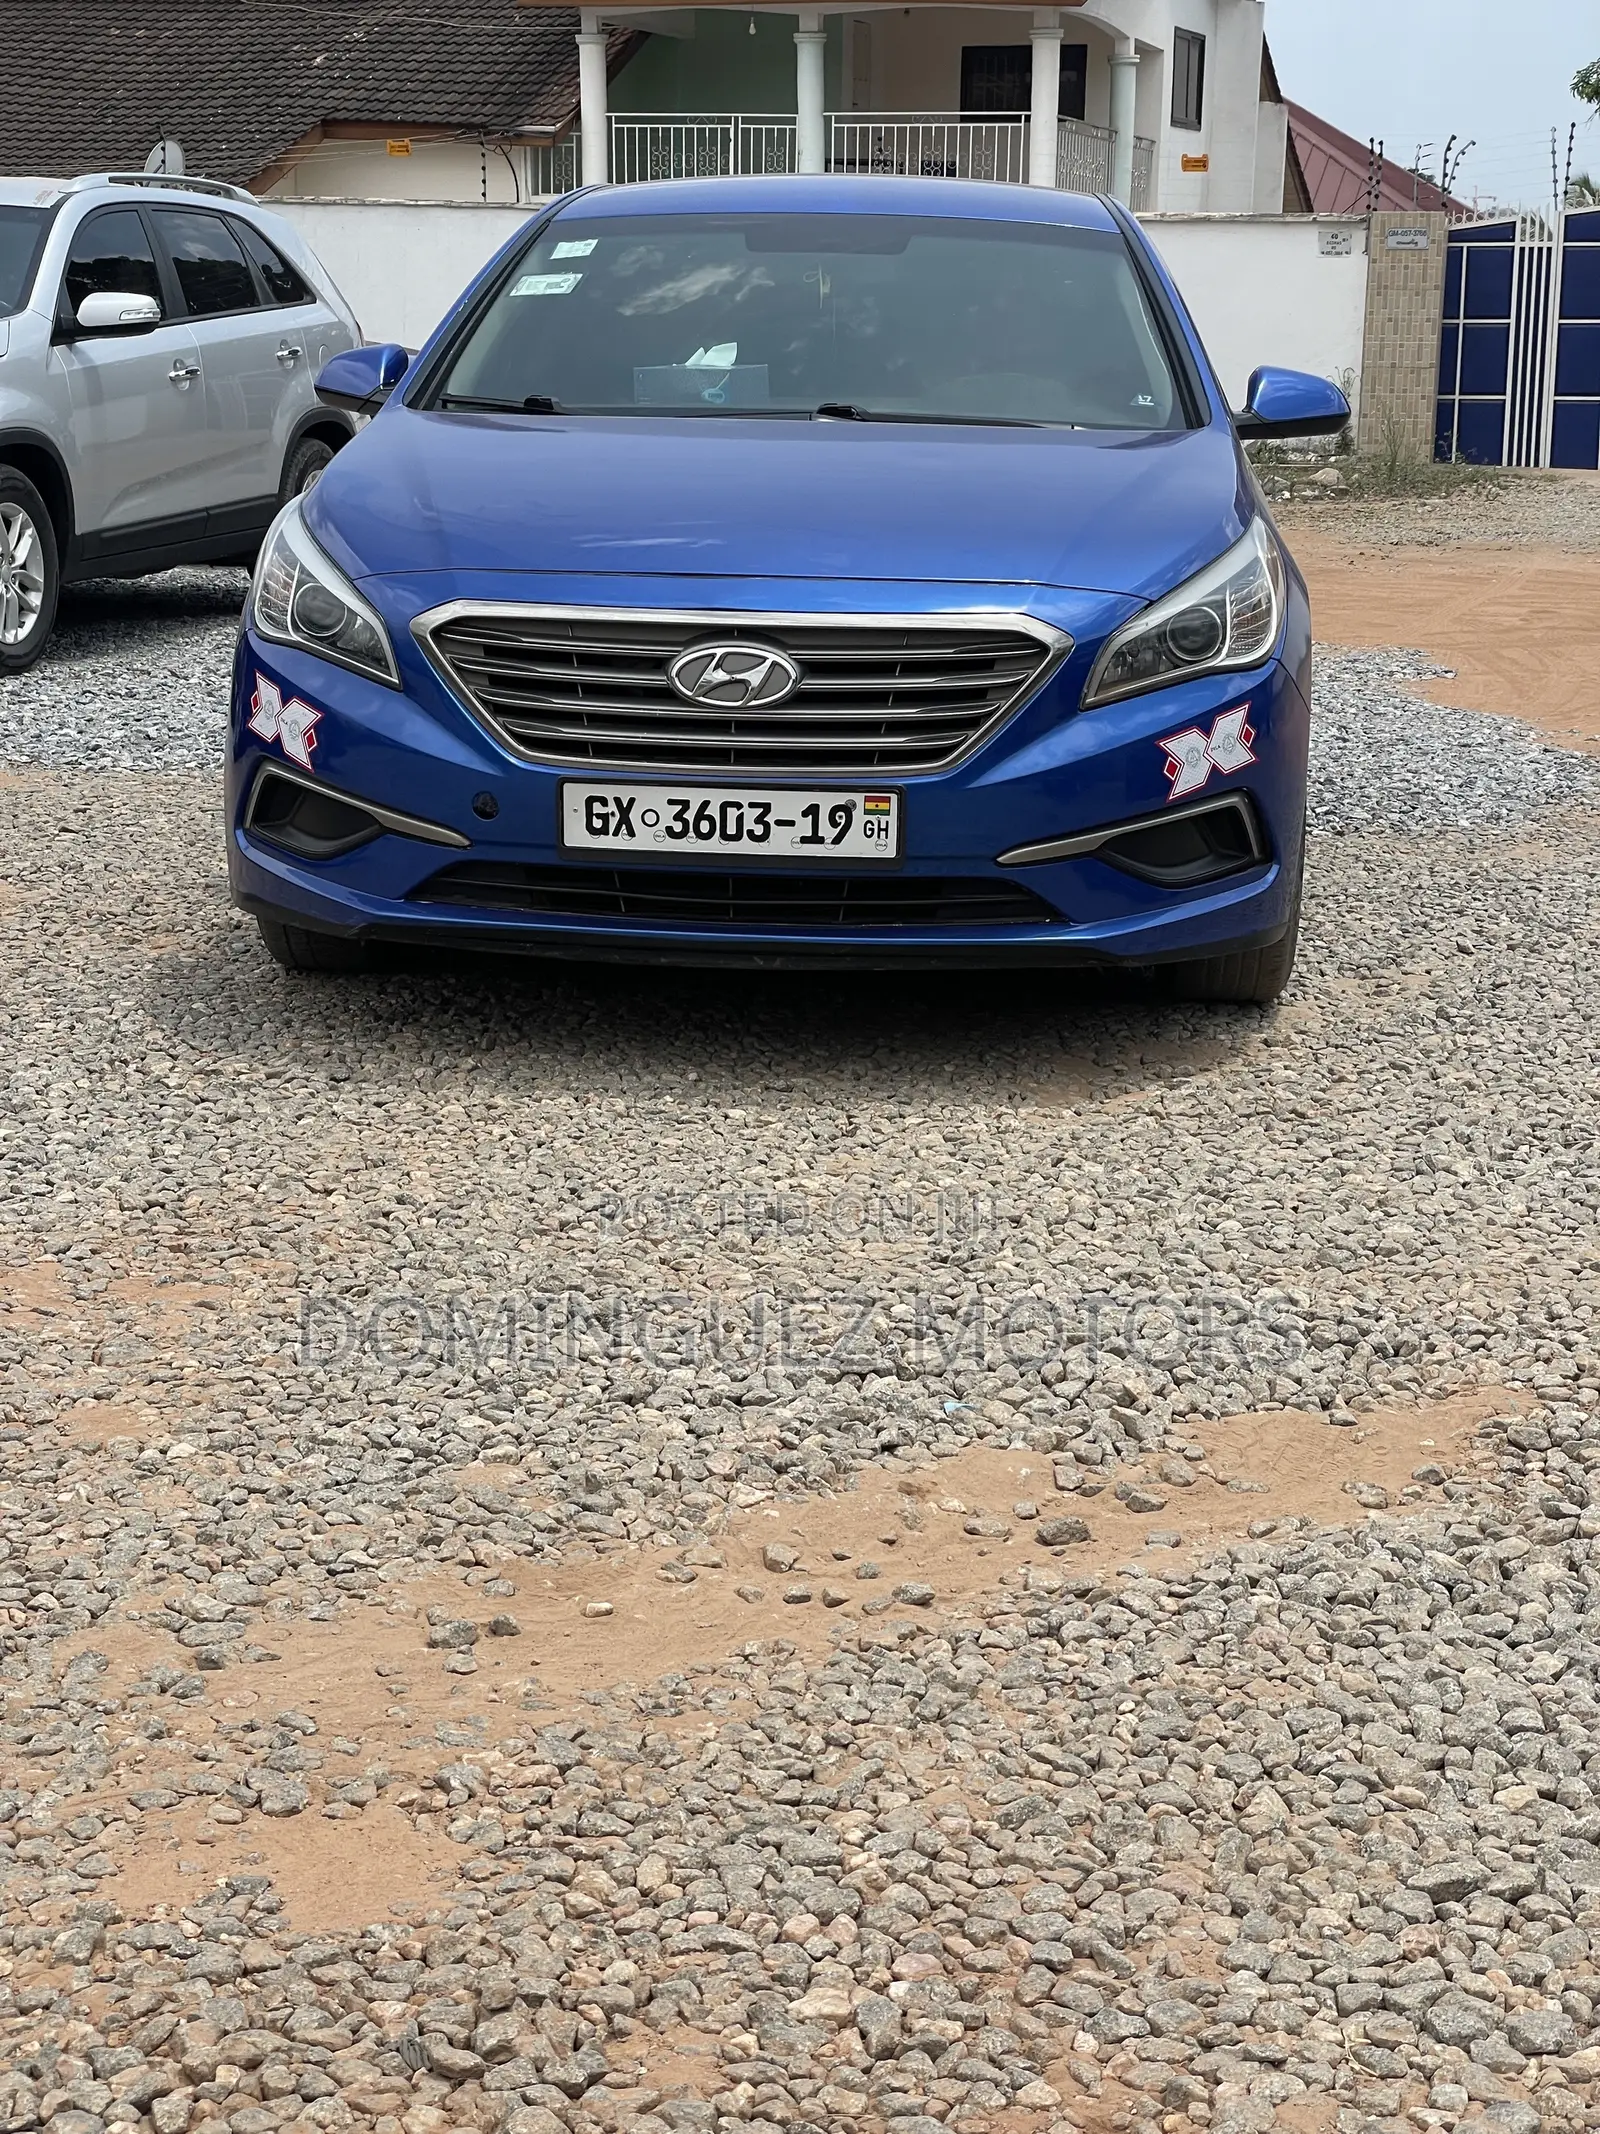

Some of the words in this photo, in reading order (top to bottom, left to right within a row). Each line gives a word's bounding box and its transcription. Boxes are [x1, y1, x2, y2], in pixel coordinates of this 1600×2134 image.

[584, 794, 637, 838] GX
[664, 797, 854, 846] 3603-19
[863, 819, 890, 840] GH
